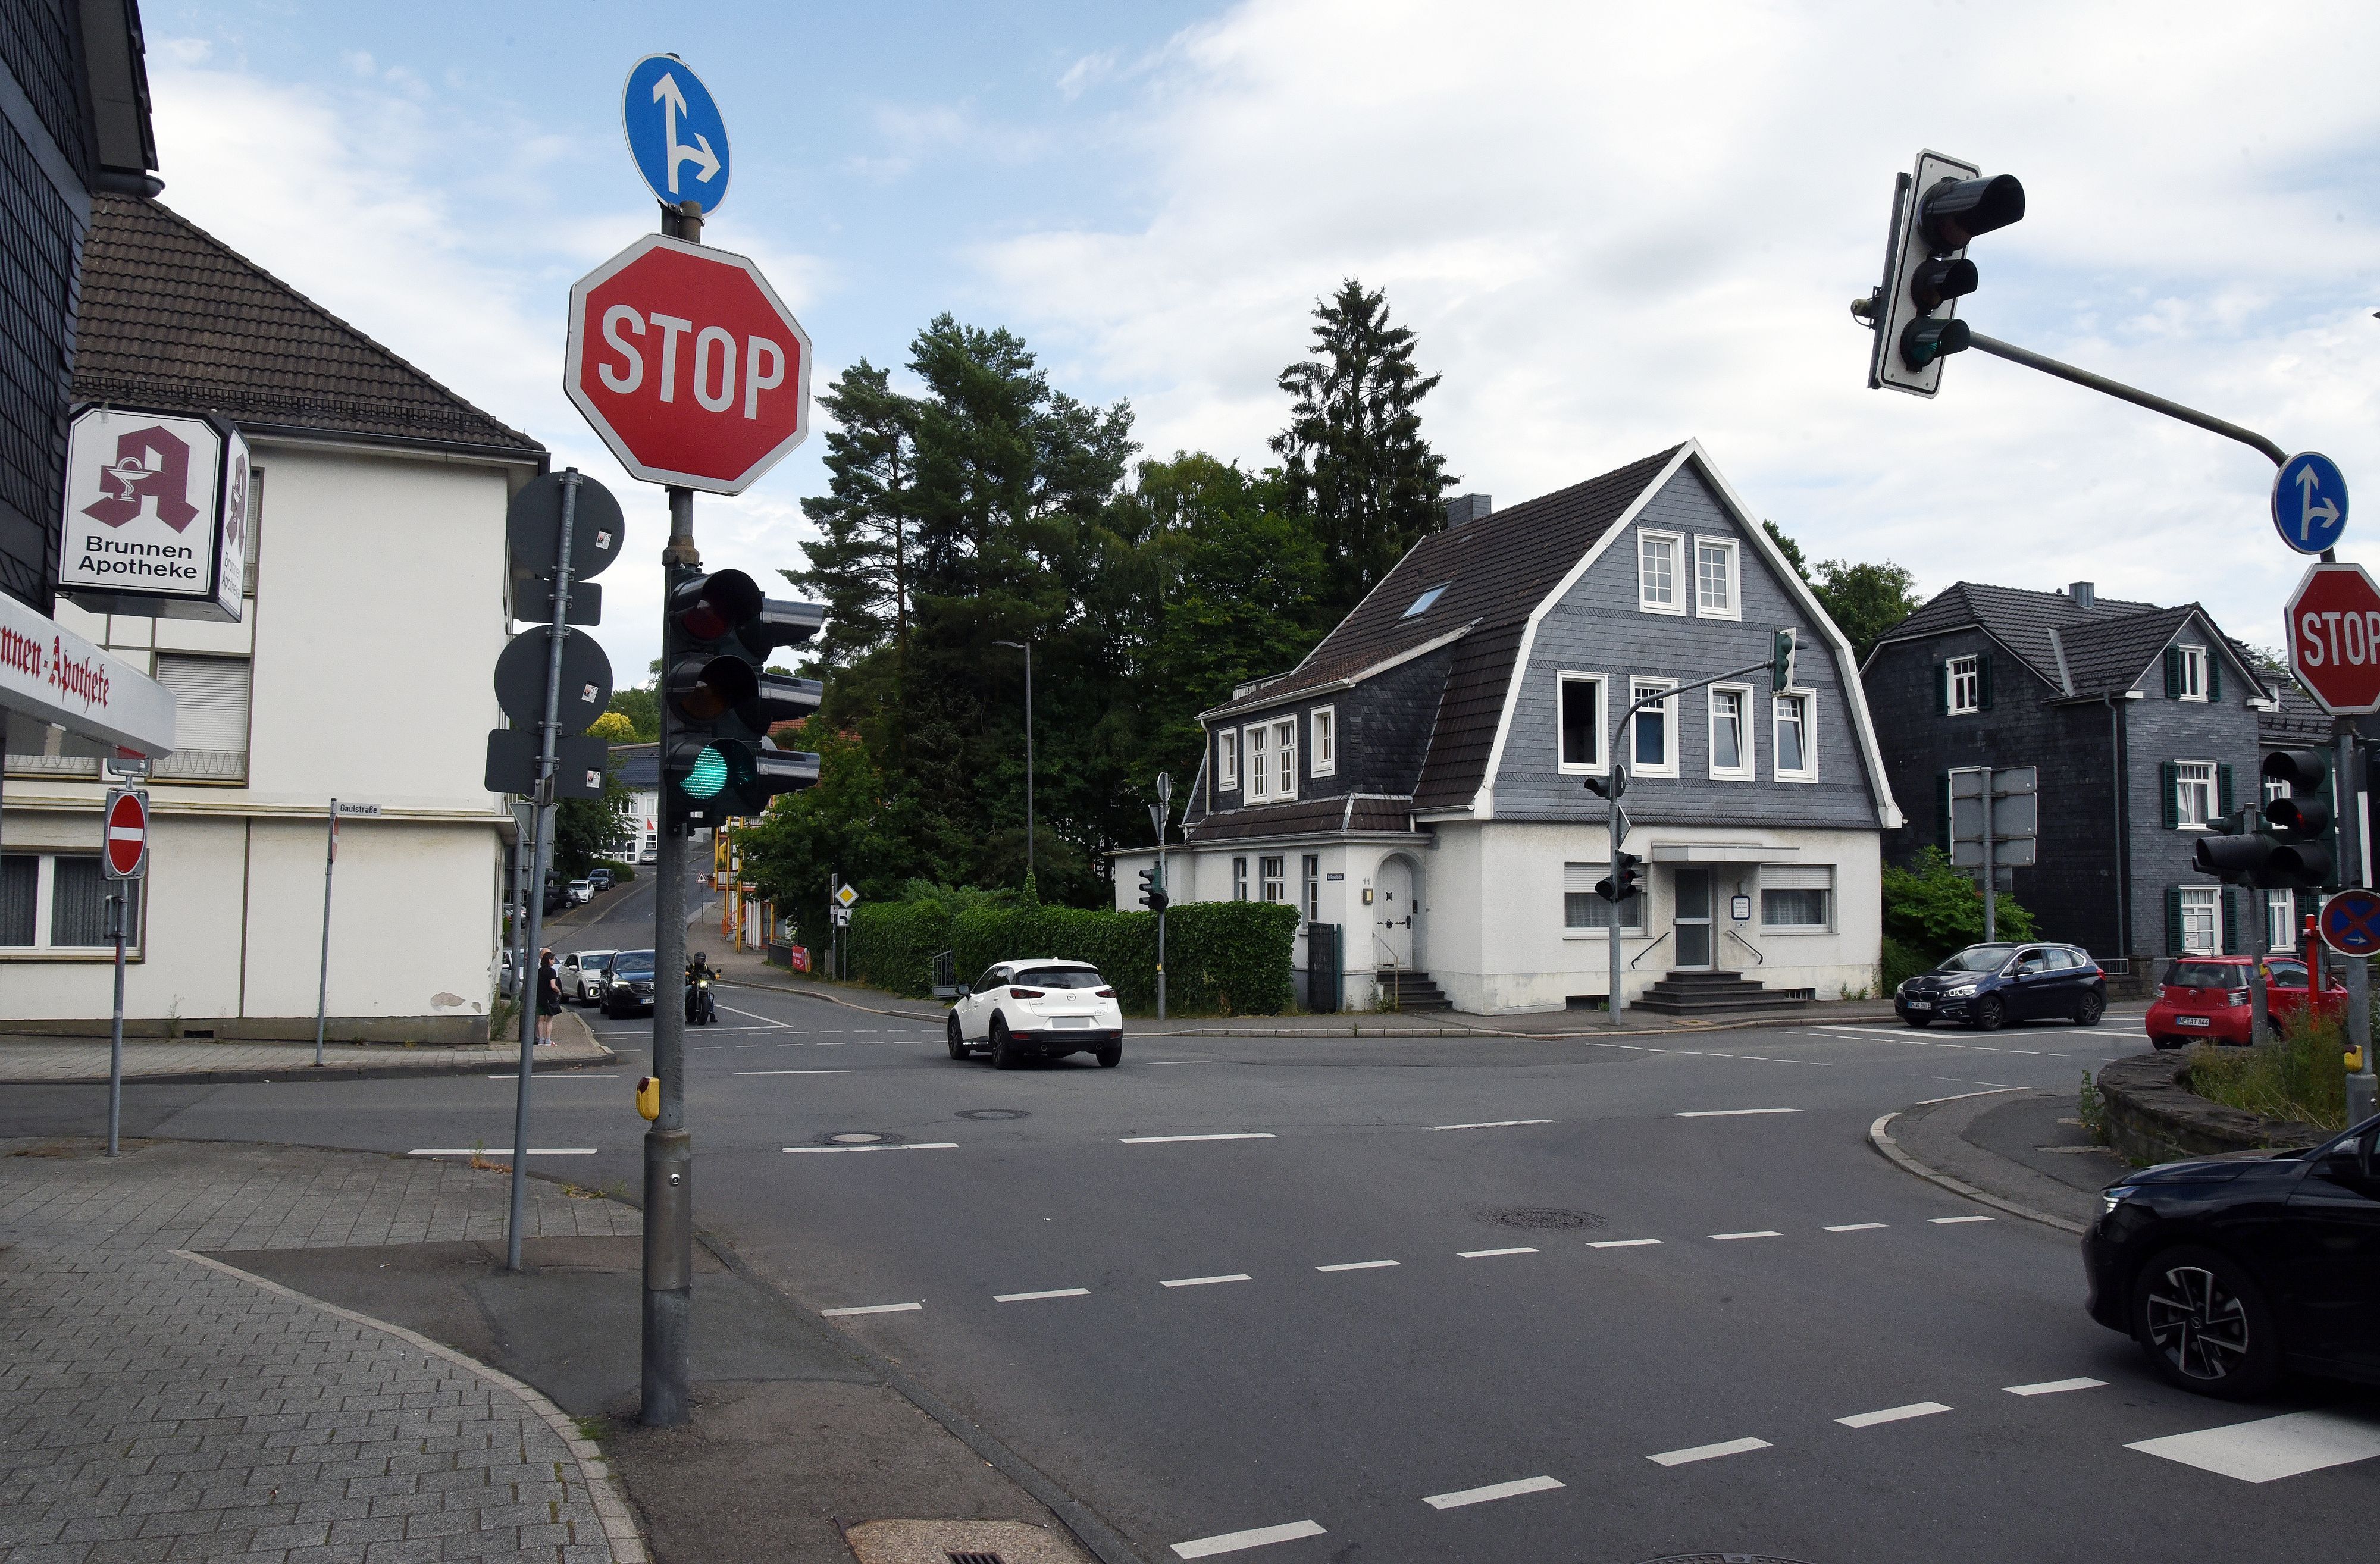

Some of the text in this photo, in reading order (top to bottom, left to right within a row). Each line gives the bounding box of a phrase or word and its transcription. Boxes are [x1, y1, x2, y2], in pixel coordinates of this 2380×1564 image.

[599, 304, 785, 420] STOP
[86, 535, 192, 559] Brunnen
[78, 555, 198, 579] Apotheke
[2302, 611, 2380, 666] STOP
[340, 804, 377, 813] Gaulstraße
